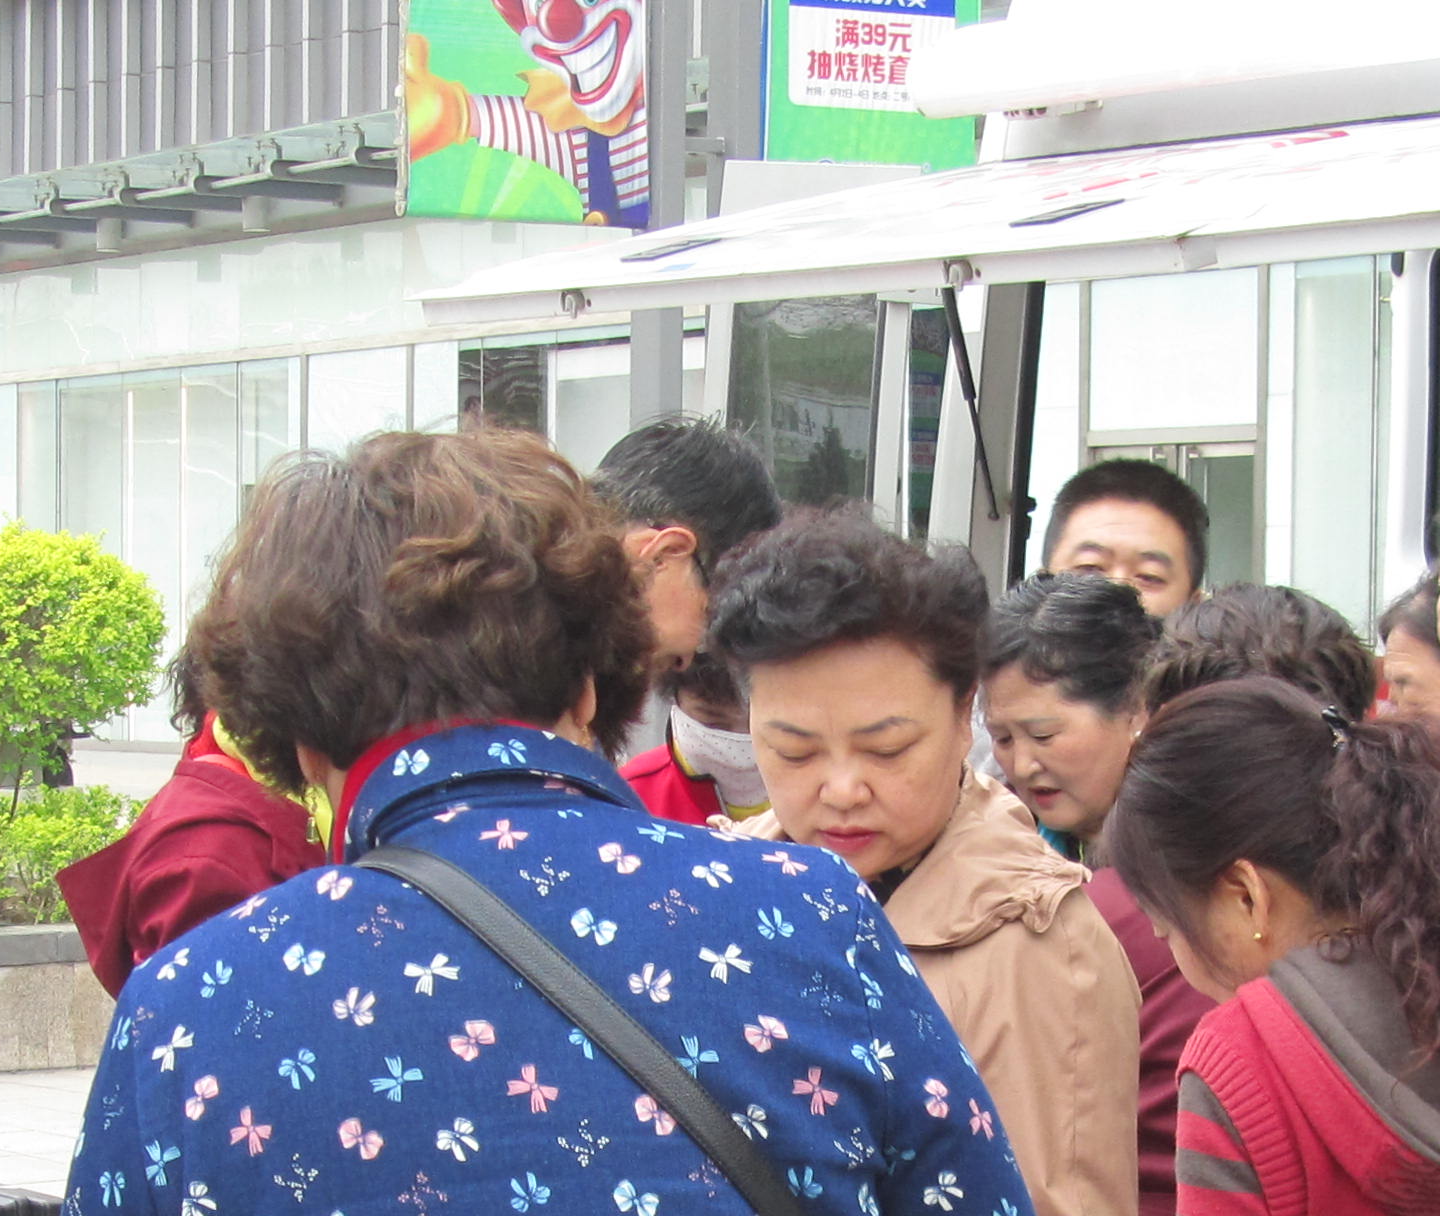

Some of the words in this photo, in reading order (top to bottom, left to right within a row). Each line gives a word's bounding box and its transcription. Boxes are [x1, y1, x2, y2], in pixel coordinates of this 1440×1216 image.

[835, 18, 912, 52] 满39元
[807, 50, 911, 85] 抽烧烤套
